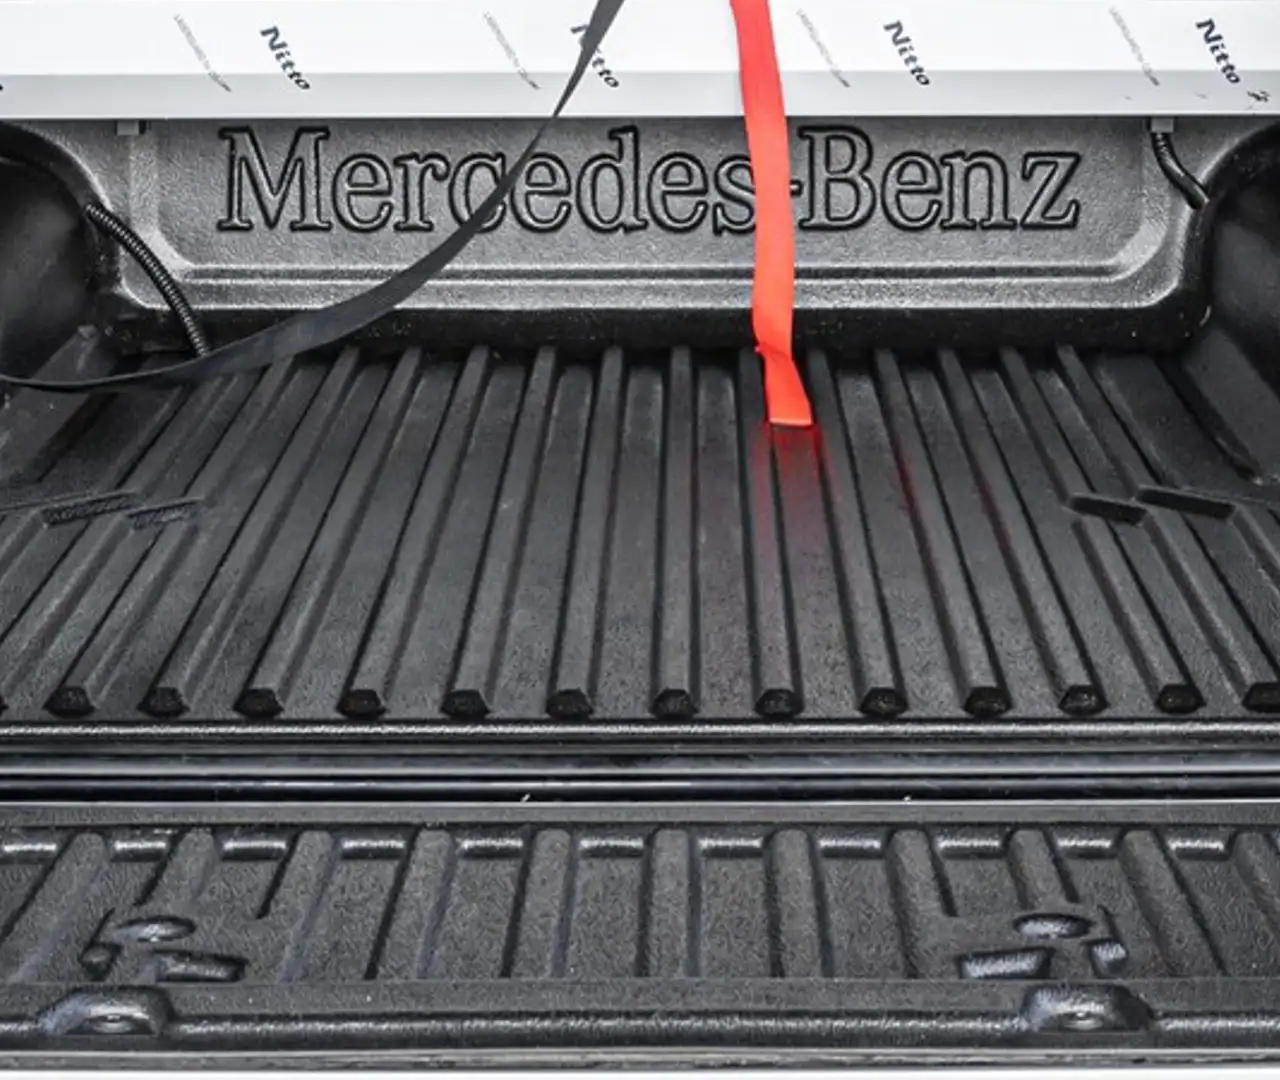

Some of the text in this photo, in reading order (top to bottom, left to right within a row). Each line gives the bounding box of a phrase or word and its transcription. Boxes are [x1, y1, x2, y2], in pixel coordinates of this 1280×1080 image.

[260, 25, 311, 91] Nitto
[883, 20, 931, 86] Nitto
[1195, 18, 1241, 85] Nitto
[217, 126, 1082, 235] MercedesBenz
